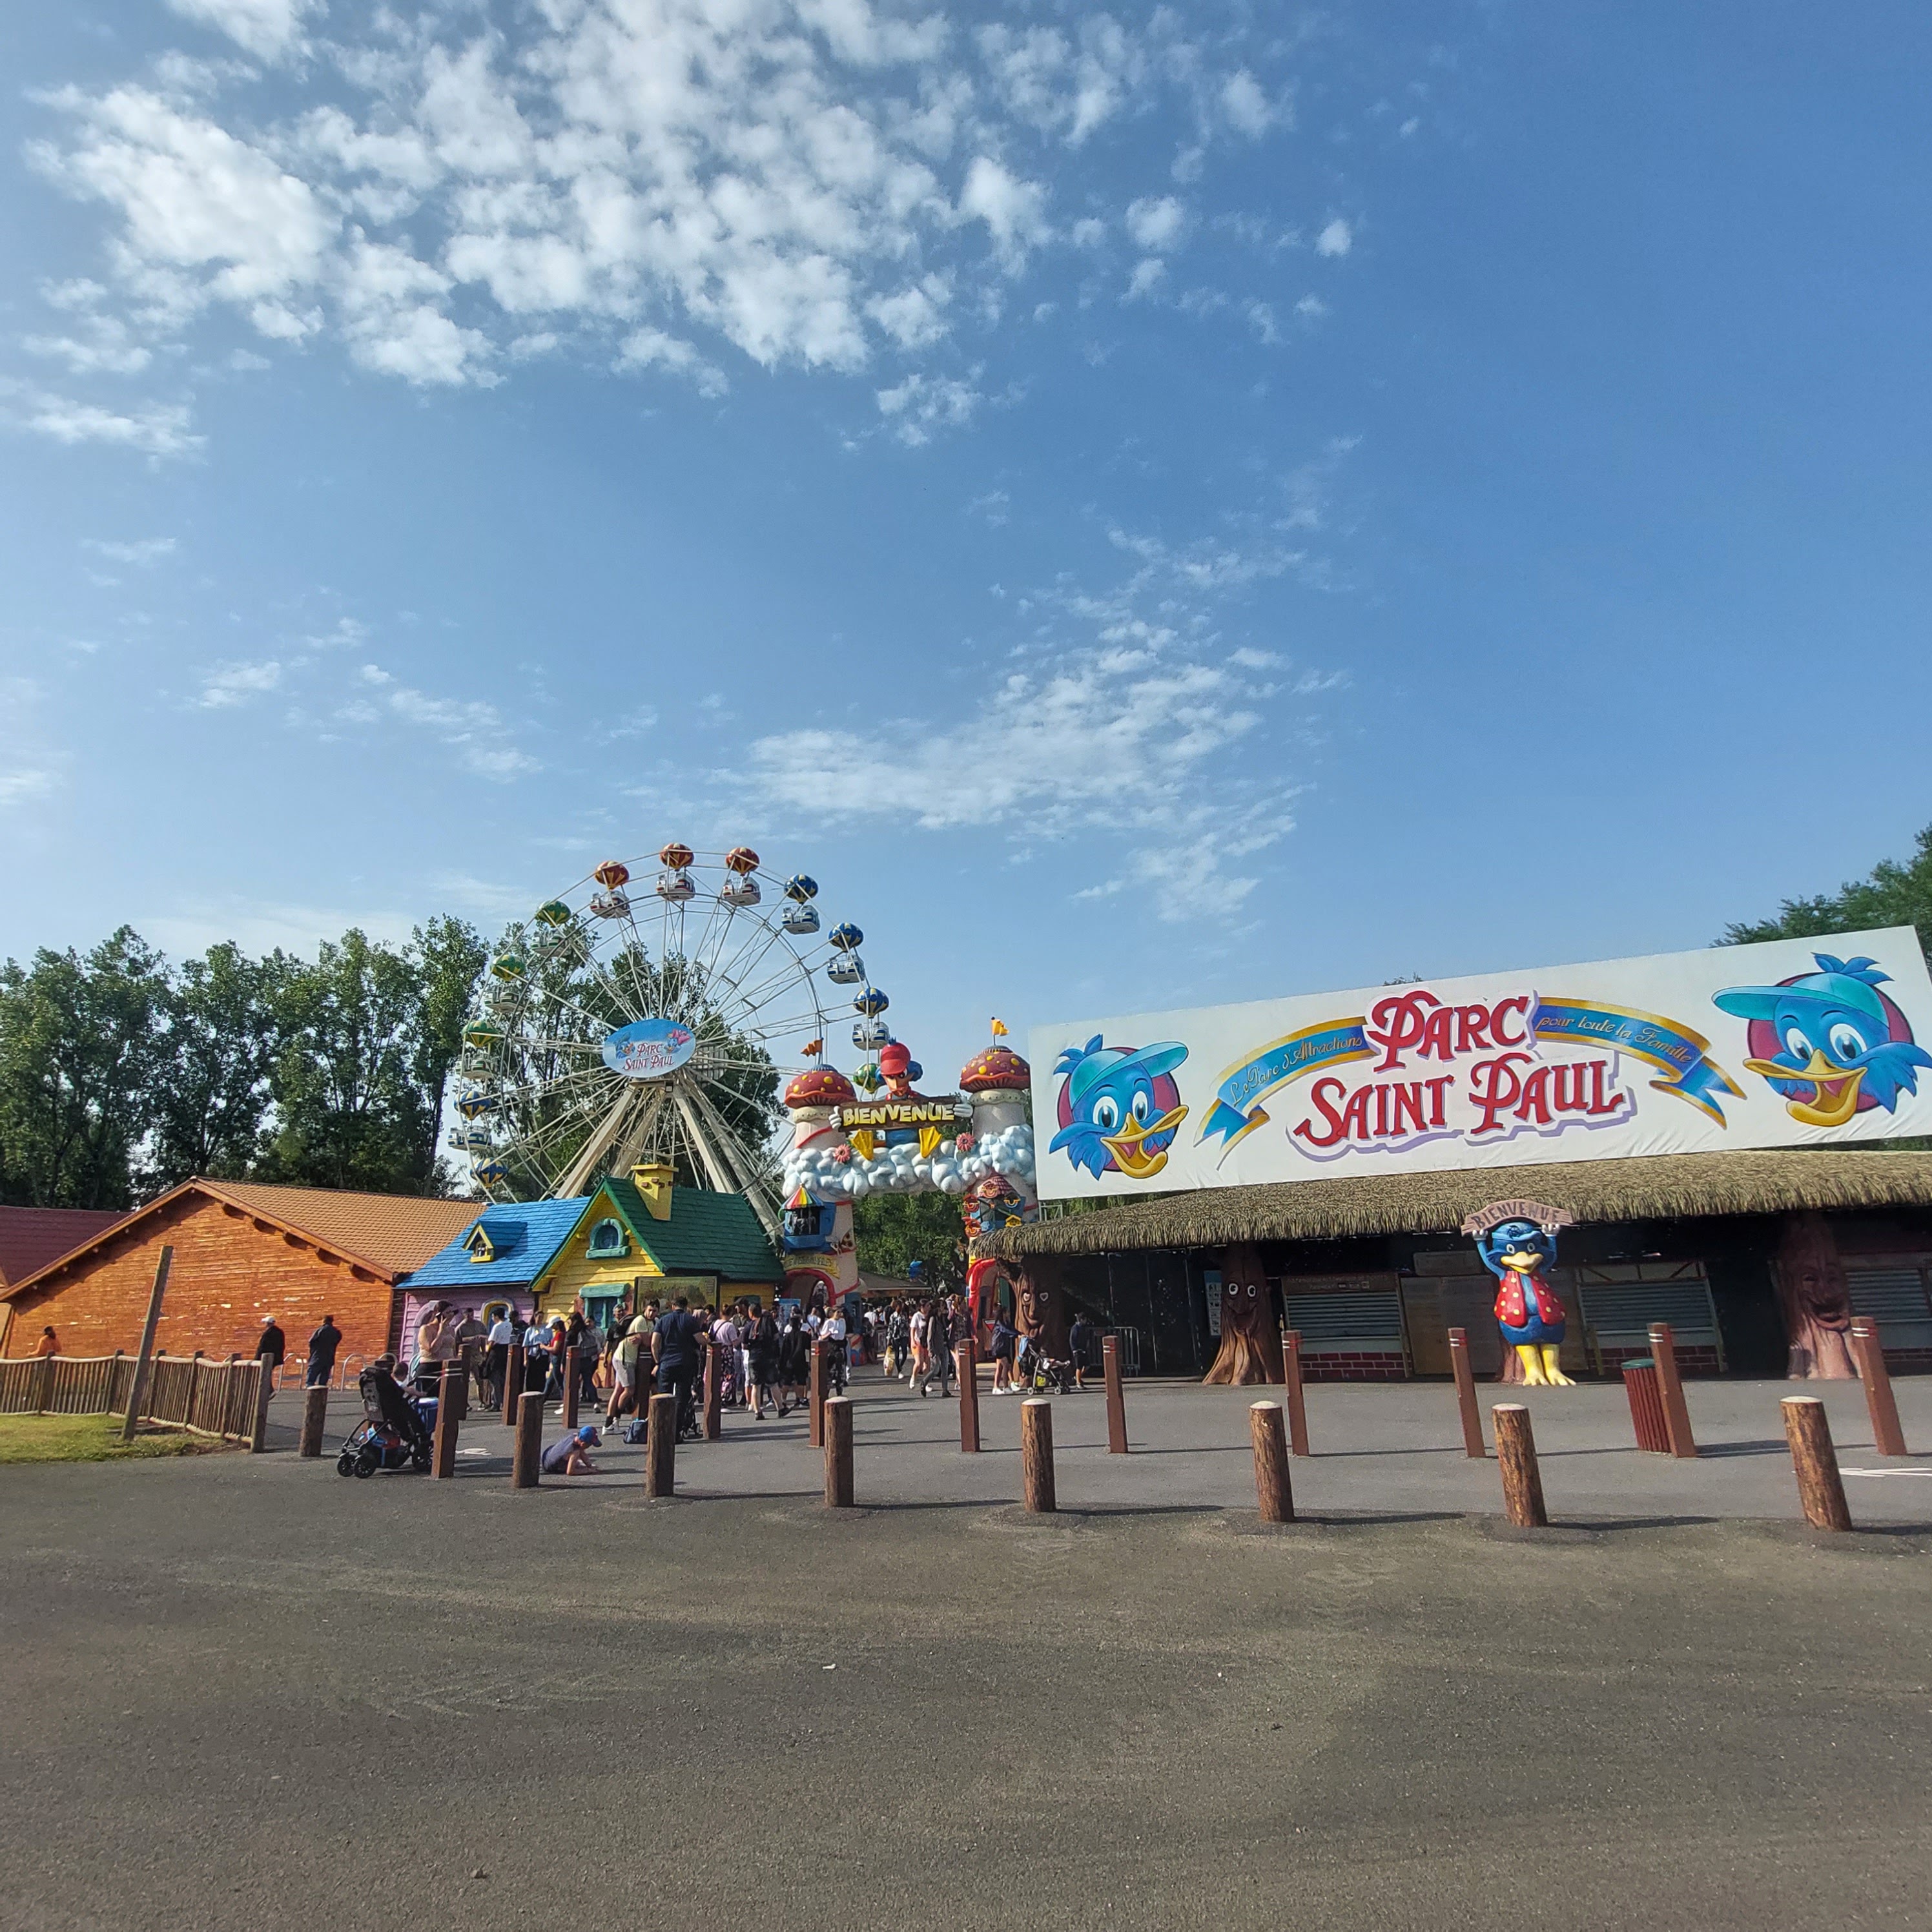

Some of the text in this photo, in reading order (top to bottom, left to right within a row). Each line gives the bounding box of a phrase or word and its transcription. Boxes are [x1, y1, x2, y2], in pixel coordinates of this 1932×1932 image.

[1366, 990, 1530, 1073] PARC
[1534, 1016, 1692, 1063] pour toute la Famille
[622, 1054, 675, 1071] SAINT PAUL
[637, 1042, 663, 1058] PARC
[1229, 1082, 1249, 1107] Le
[1247, 1066, 1280, 1088] Parc
[1293, 1053, 1625, 1147] SAINT PAUL
[843, 1102, 955, 1126] BIENVENUE
[1471, 1201, 1560, 1229] BIENVENUE
